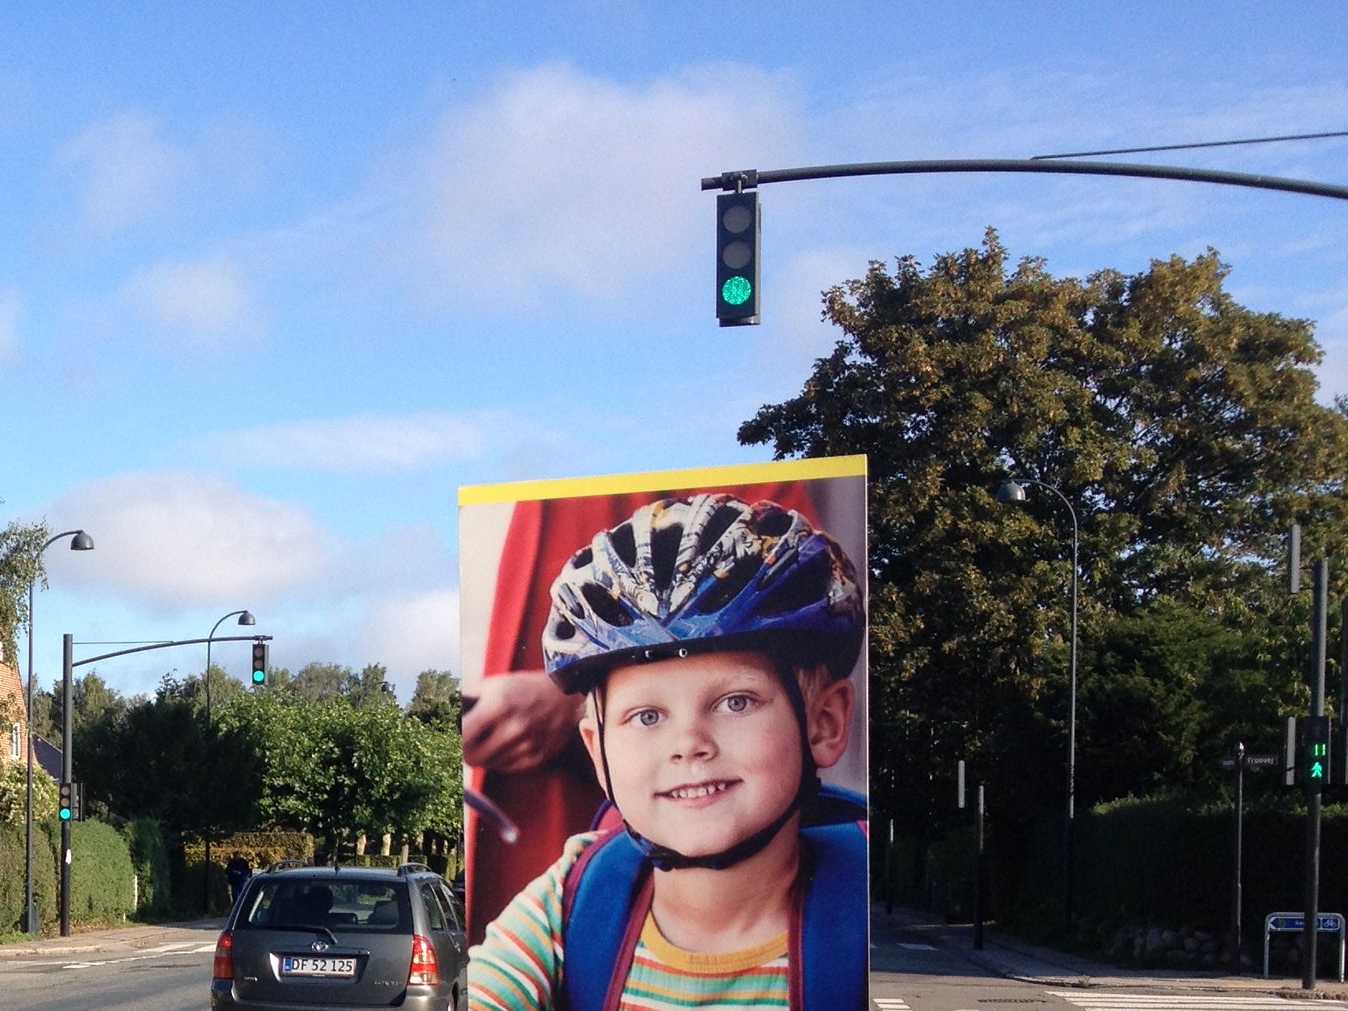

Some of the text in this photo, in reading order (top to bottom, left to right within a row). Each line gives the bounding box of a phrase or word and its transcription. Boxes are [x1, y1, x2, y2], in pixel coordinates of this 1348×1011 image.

[291, 958, 353, 972] DF 52 125
